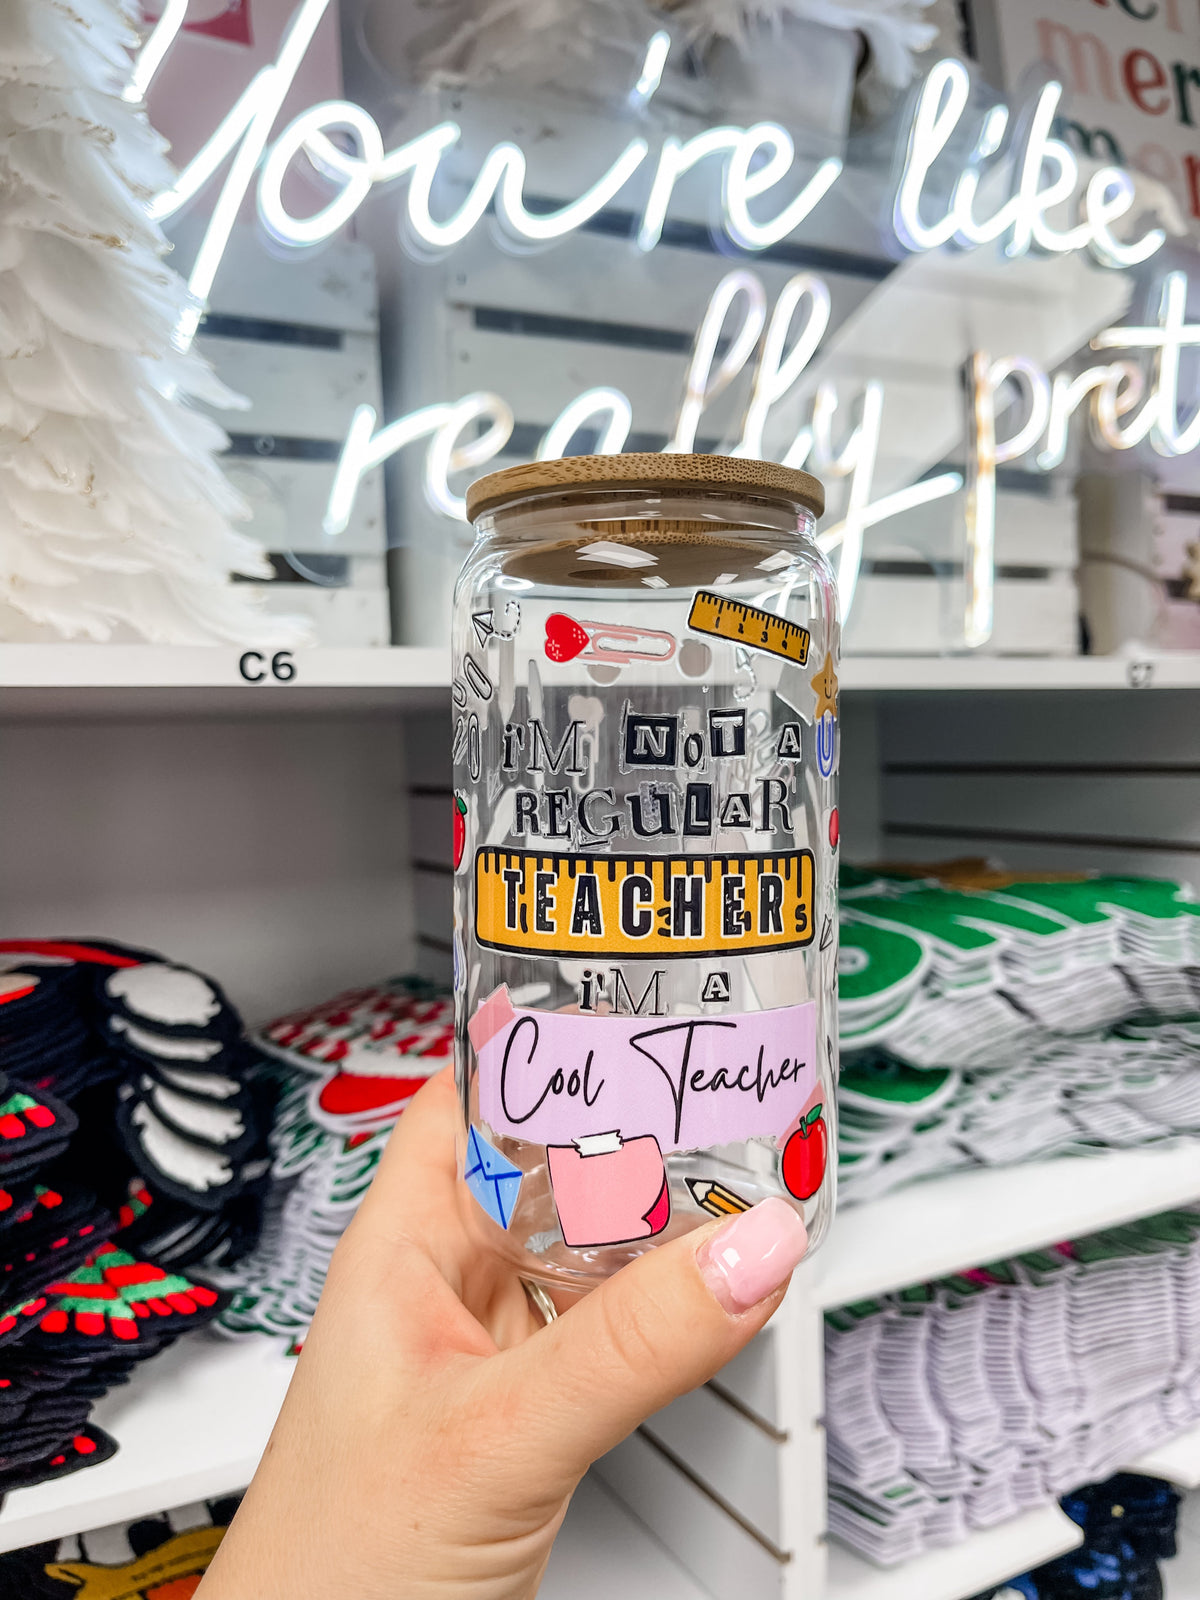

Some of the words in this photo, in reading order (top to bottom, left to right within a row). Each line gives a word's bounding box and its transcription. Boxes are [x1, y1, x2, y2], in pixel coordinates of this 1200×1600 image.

[893, 58, 1166, 268] like
[239, 651, 297, 681] C6
[778, 724, 801, 758] A
[503, 869, 784, 938] TEACHER
[702, 972, 729, 1002] A
[501, 1016, 604, 1123] Cool
[629, 1020, 806, 1144] Teacher
